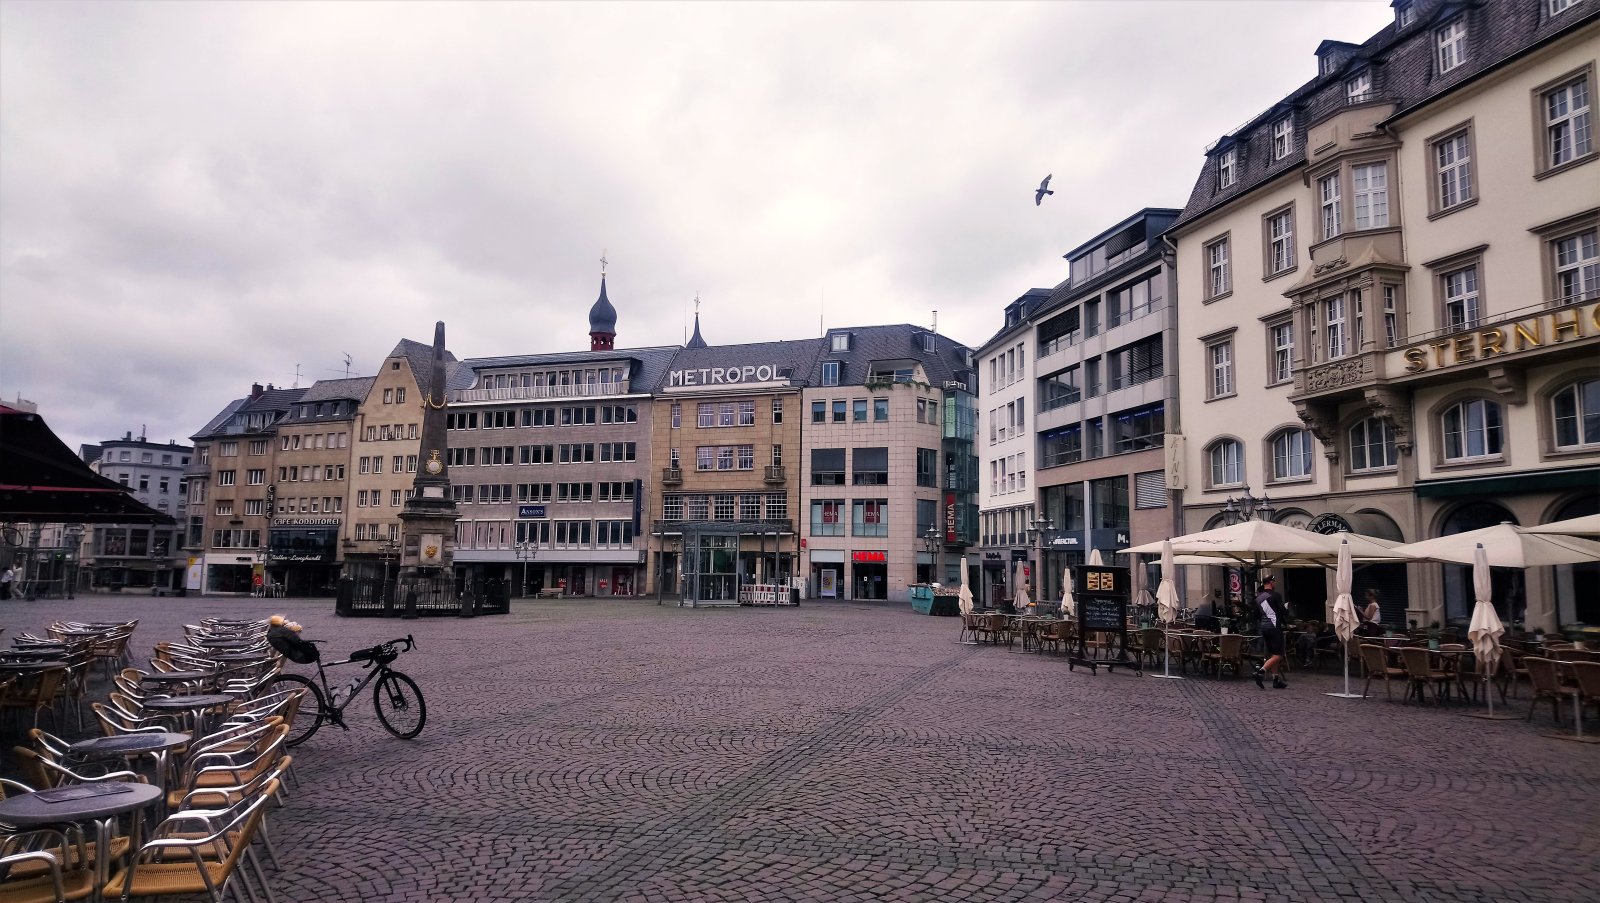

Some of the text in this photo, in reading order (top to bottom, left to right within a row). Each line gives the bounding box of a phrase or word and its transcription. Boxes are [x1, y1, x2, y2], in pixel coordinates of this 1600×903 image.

[670, 364, 787, 386] METROPOL
[947, 503, 955, 533] HEMA
[853, 551, 886, 561] HEMA
